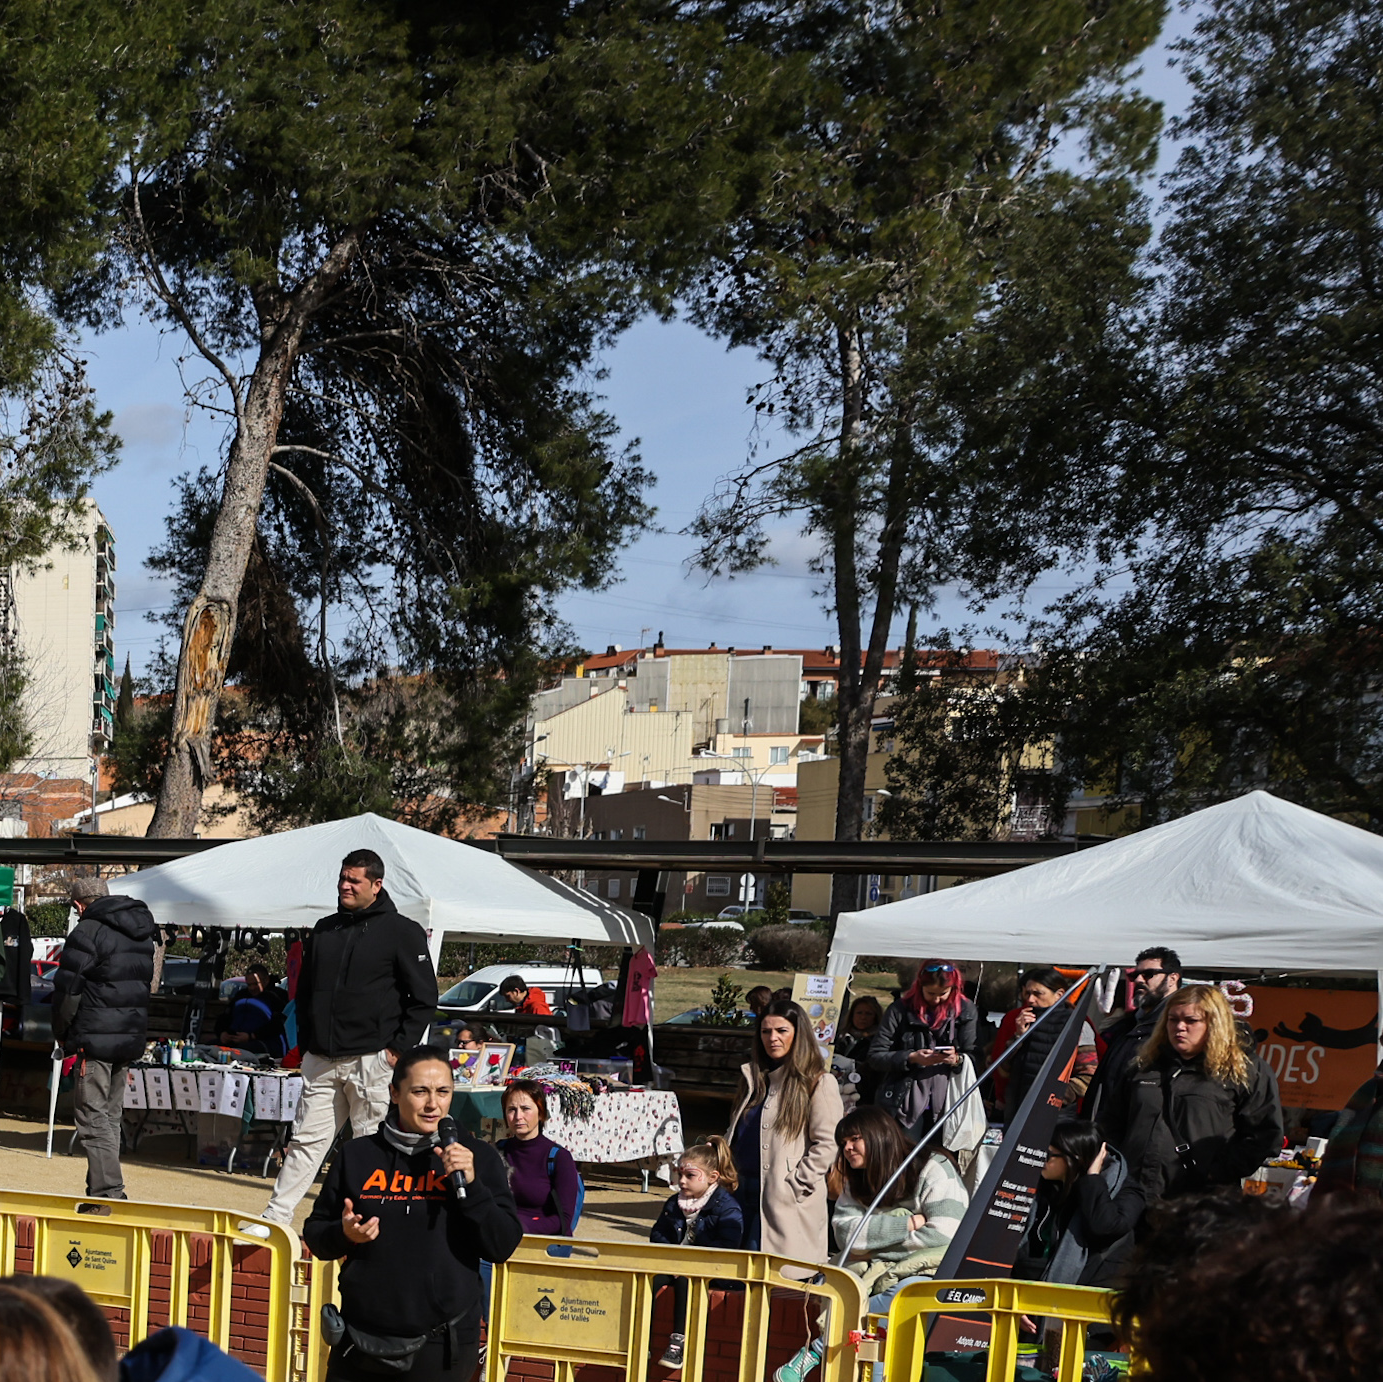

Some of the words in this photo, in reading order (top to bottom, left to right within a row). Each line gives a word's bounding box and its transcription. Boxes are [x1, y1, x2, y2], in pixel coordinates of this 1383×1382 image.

[362, 1168, 447, 1193] Atuk
[560, 1296, 600, 1307] Ajuntament
[569, 1306, 584, 1314] Sant
[585, 1306, 607, 1316] Quirze
[559, 1313, 570, 1321] del
[571, 1314, 590, 1323] Vallès
